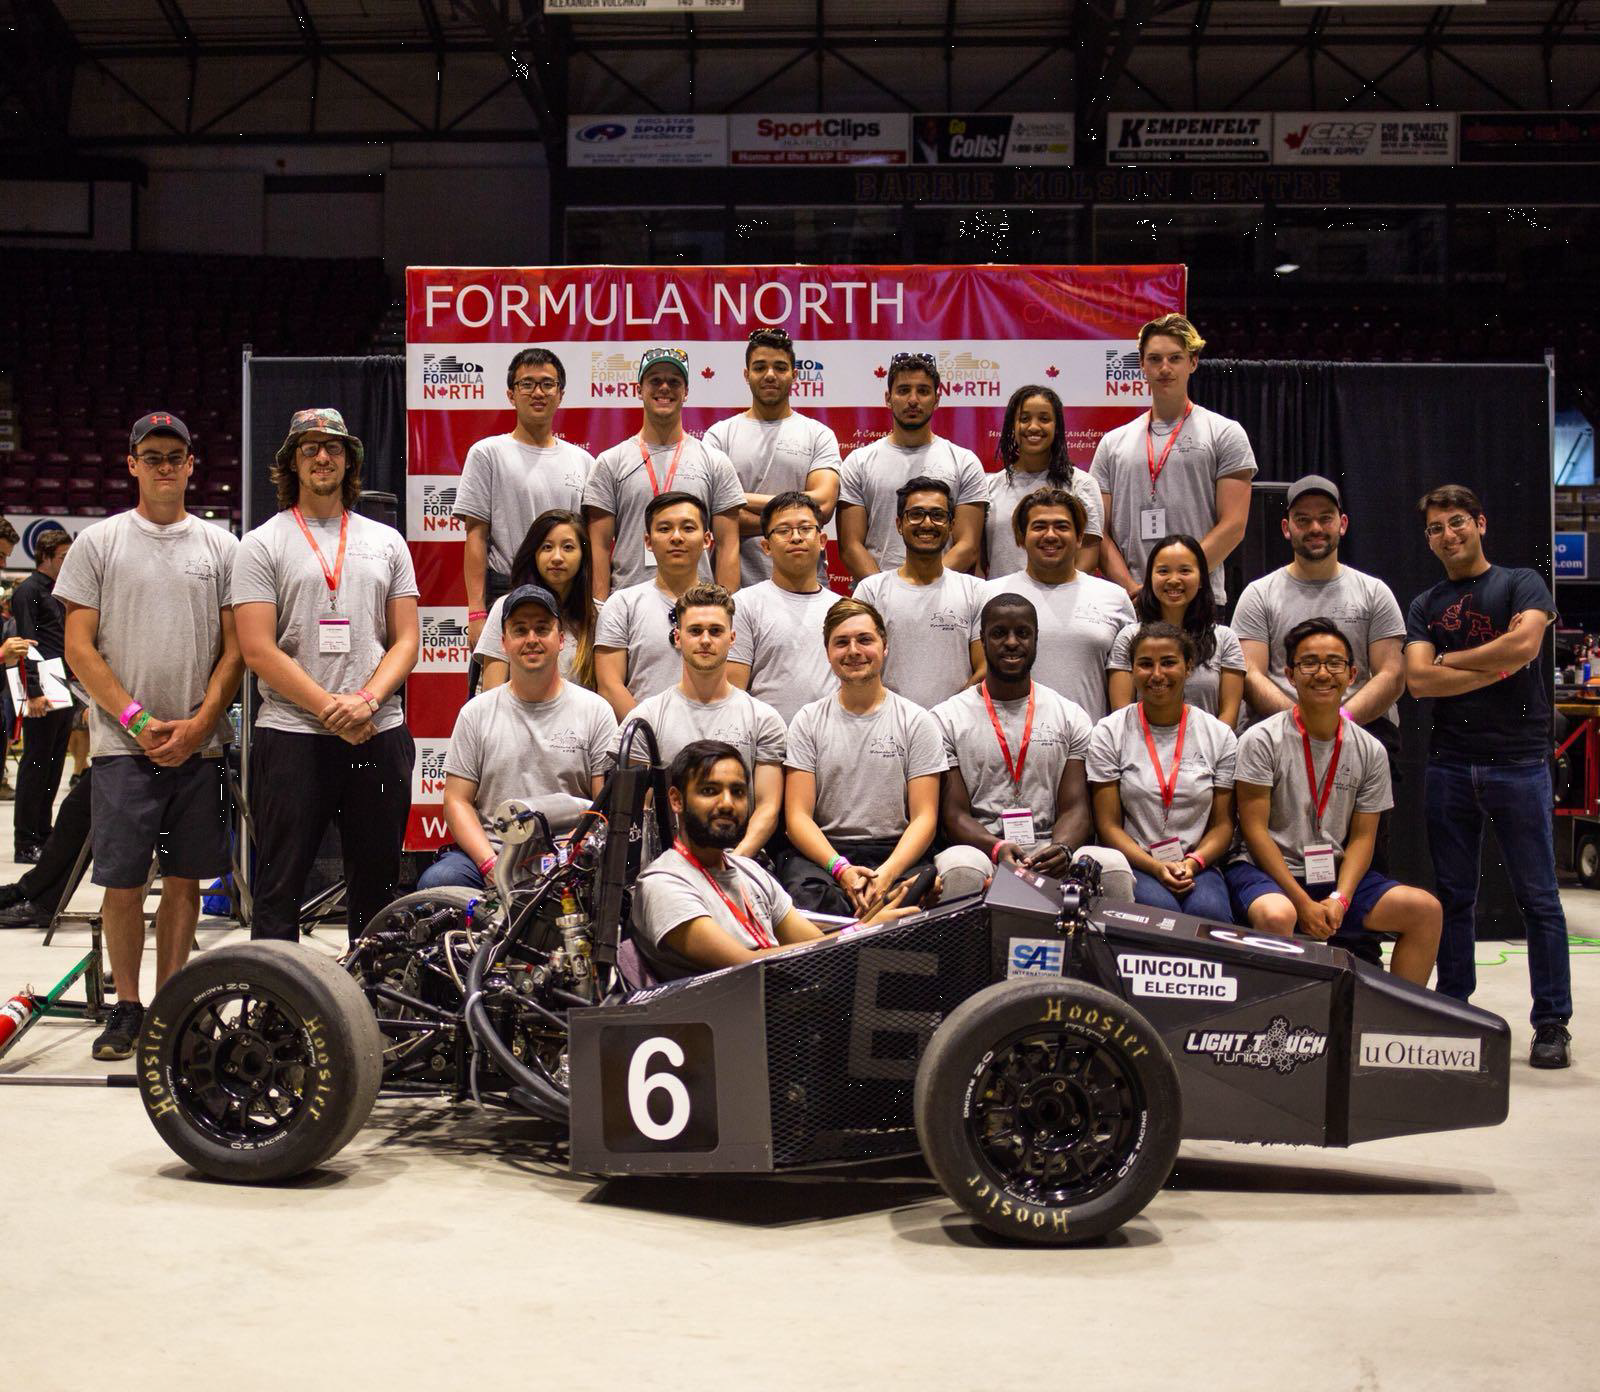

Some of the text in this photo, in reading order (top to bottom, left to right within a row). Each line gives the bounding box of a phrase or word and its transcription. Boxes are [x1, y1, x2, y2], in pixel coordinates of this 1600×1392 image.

[634, 125, 696, 133] SPORTS
[757, 118, 880, 142] SportClips
[1119, 118, 1261, 148] KEMPENFELT
[1381, 123, 1449, 132] FOR PROJECTS
[1381, 132, 1399, 142] BIG
[1413, 132, 1448, 142] SMALL
[950, 134, 1006, 159] Colts!
[1144, 138, 1259, 146] OVERHEAD DOORS
[855, 171, 1345, 202] BARRIE MOLSON CENTRE
[425, 282, 904, 328] FORMULA NORTH
[423, 373, 484, 384] FORMULA
[591, 371, 634, 382] FORMU
[1066, 440, 1096, 449] tudent
[422, 637, 468, 647] FORMU
[1013, 945, 1062, 971] SAE
[1122, 958, 1216, 979] LINCOLN
[1144, 981, 1227, 997] ELECTRIC
[1040, 996, 1149, 1058] Hoosier
[1186, 1033, 1249, 1051] LIGHT
[144, 1016, 180, 1119] Hoosier
[302, 1015, 333, 1121] Hoosier
[627, 1036, 691, 1141] 6
[963, 1078, 977, 1119] RACING
[257, 1130, 288, 1148] RACING
[1135, 1110, 1148, 1150] RACING
[966, 1172, 1074, 1235] Hoosier
